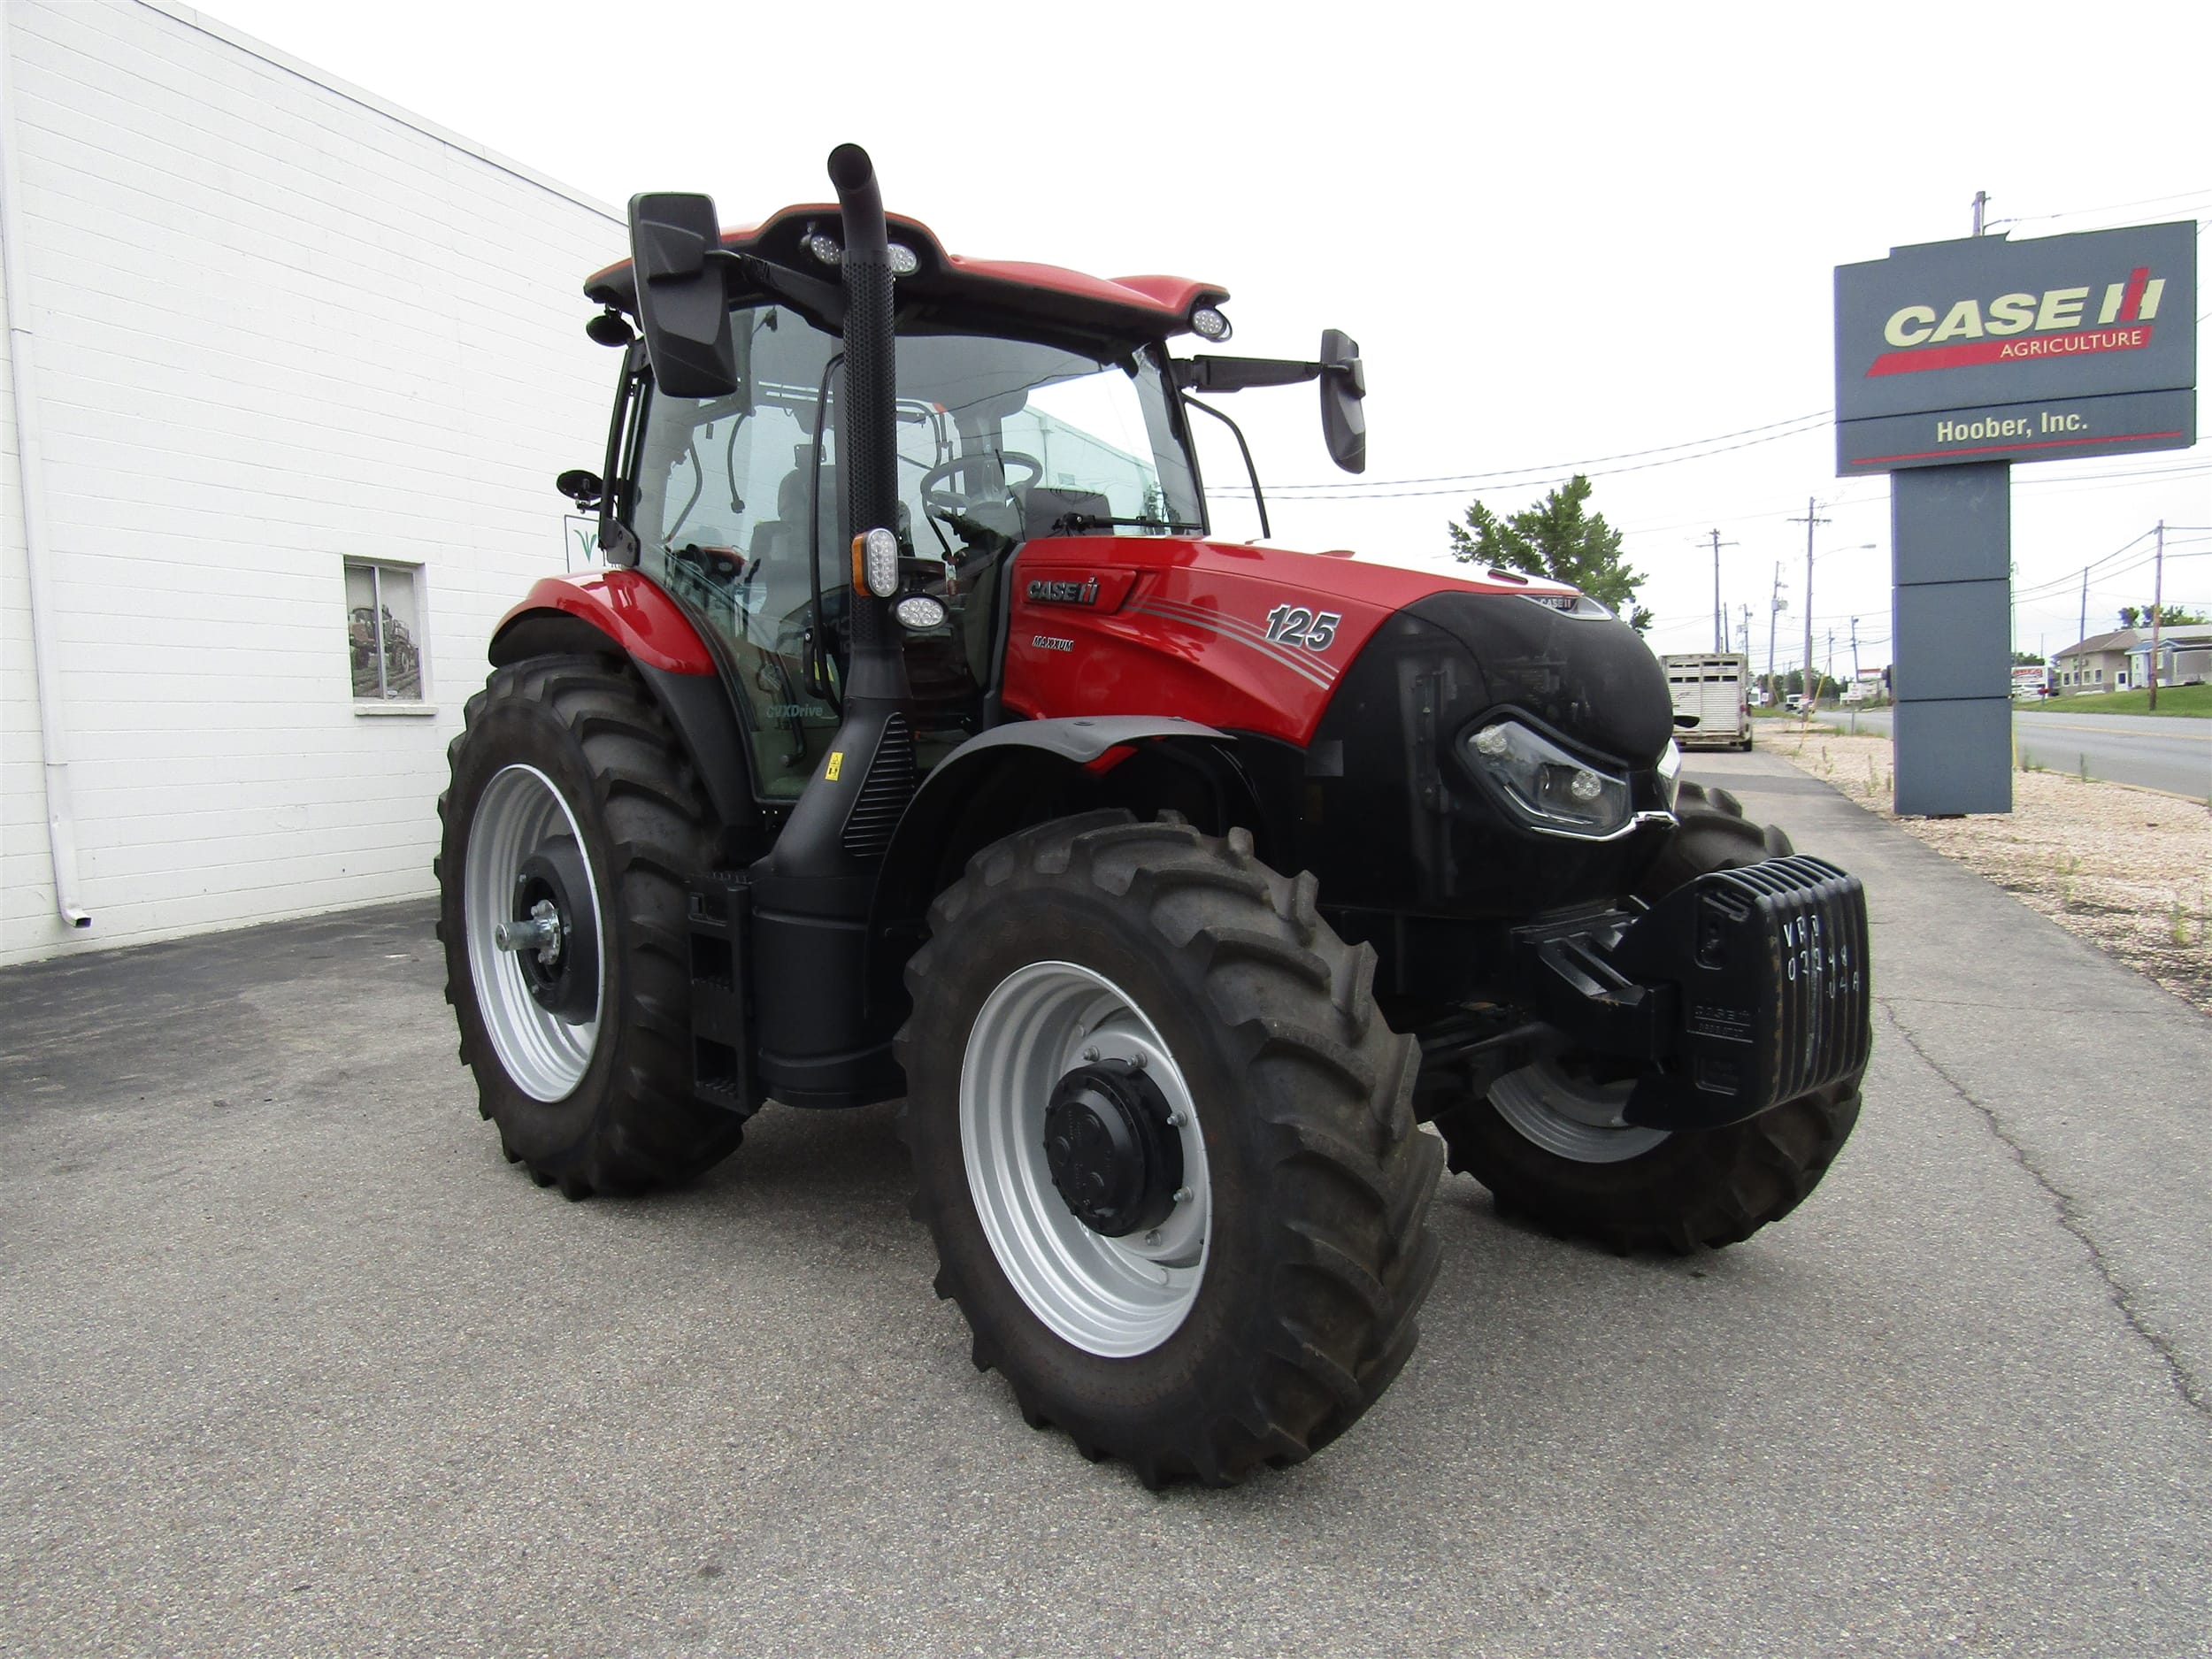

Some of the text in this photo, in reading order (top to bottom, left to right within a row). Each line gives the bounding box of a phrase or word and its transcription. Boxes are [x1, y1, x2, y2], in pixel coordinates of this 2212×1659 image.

[1884, 287, 2090, 347] CASE
[2000, 330, 2142, 357] AGRICULTURE
[1937, 411, 2088, 442] Hoober, Inc.
[1027, 580, 1079, 602] CASE
[1540, 598, 1563, 609] CASE
[1265, 603, 1342, 652] 125
[1033, 635, 1074, 652] MAXXUM
